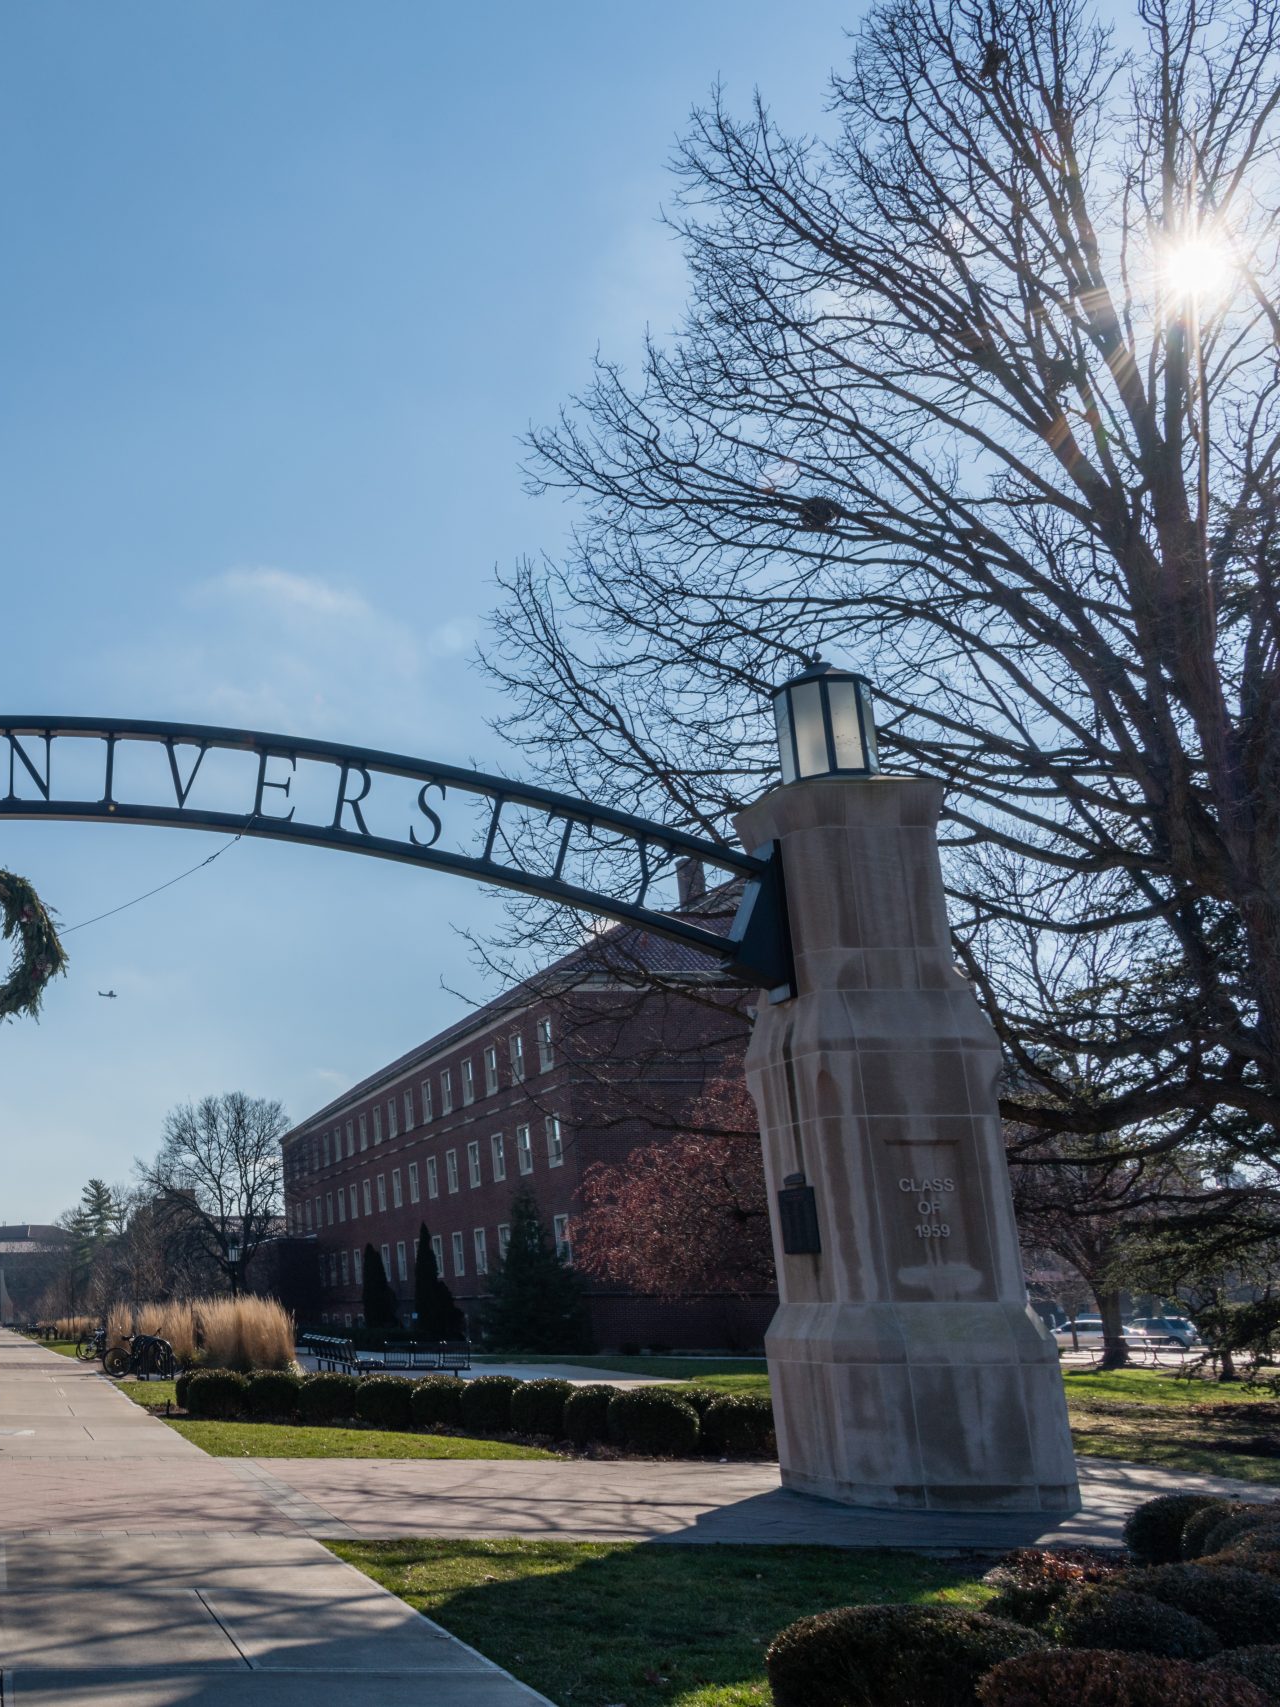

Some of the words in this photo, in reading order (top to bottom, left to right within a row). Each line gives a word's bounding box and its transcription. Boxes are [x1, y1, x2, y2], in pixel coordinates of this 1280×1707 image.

[898, 1178, 955, 1192] CLASS
[918, 1201, 940, 1215] OF
[914, 1223, 951, 1238] 1959
